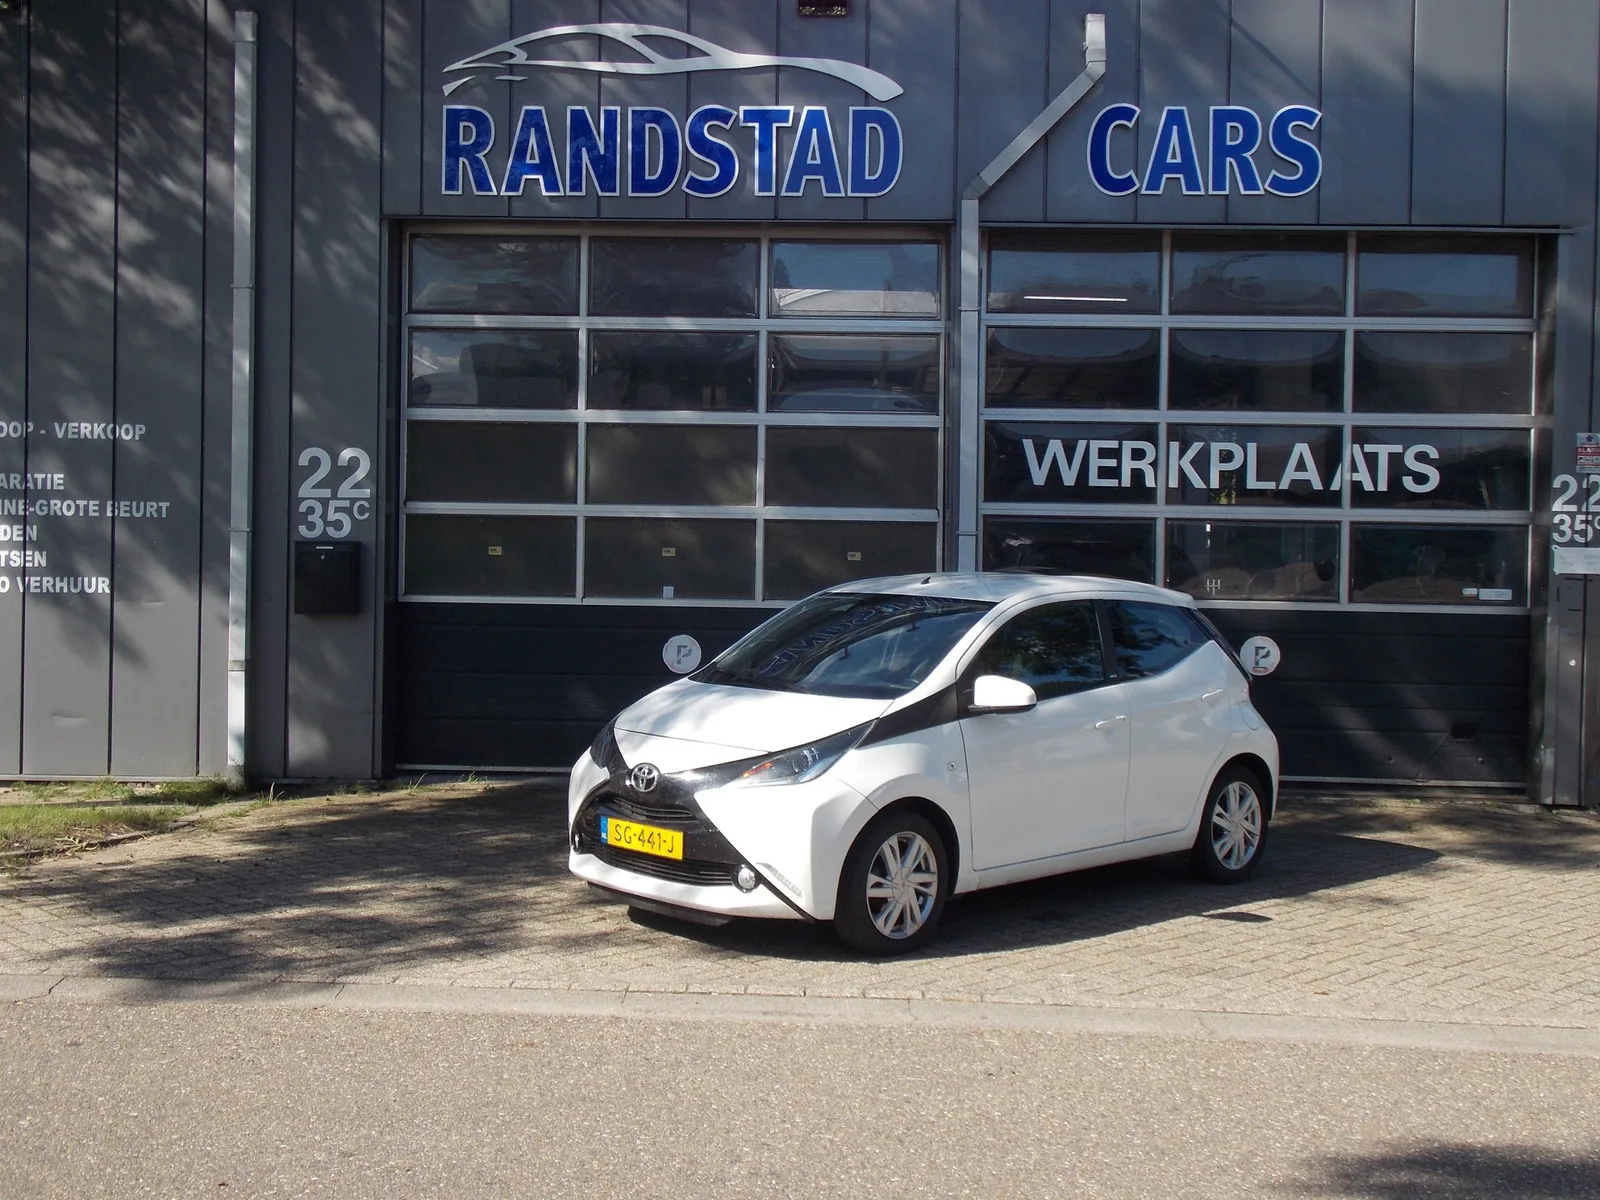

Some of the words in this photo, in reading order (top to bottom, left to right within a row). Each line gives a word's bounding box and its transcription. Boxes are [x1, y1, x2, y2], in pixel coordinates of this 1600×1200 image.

[441, 104, 905, 199] RANDSTAD
[1086, 103, 1324, 198] CARS
[54, 422, 147, 441] VERKOOP
[297, 447, 371, 498] 22
[1022, 439, 1440, 493] WERKPLAATS
[106, 500, 170, 519] BEURT
[1552, 474, 1600, 512] 22
[16, 576, 111, 594] VERHUUR
[615, 824, 674, 853] SG-441-J
